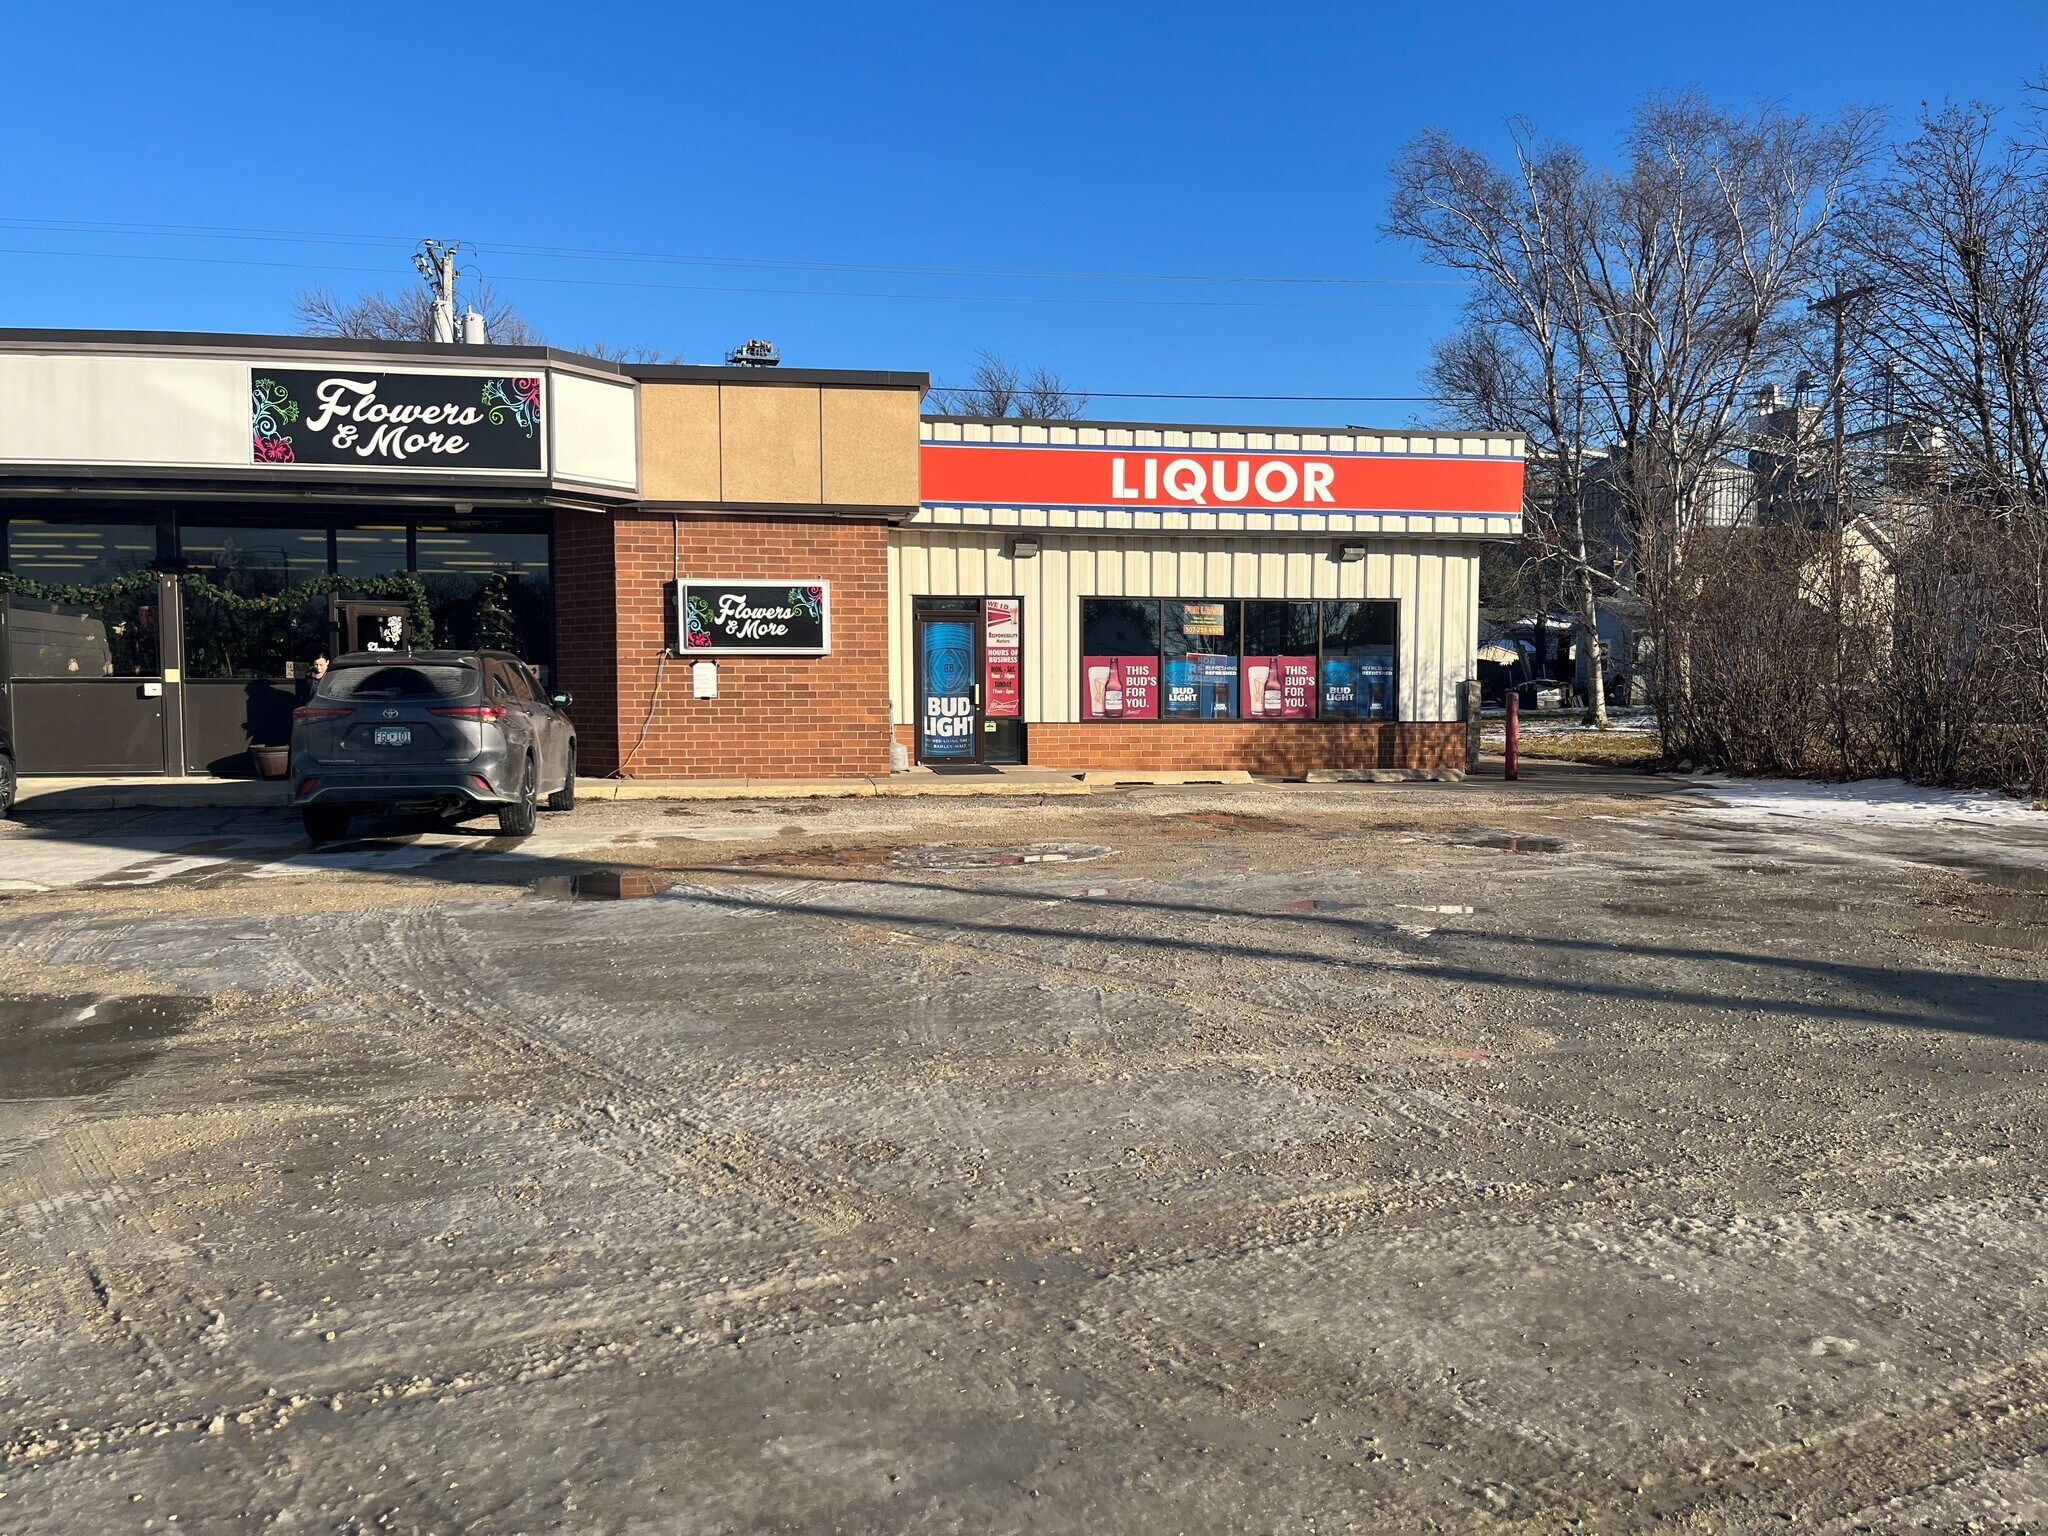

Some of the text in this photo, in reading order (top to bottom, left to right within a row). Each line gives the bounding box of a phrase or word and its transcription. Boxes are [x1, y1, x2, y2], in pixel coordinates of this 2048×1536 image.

[306, 378, 484, 432] Flowers
[332, 423, 470, 460] & More
[1112, 457, 1336, 505] LIQUOR
[987, 600, 999, 608] WE
[714, 593, 795, 626] Flowers
[725, 619, 789, 640] & More
[988, 649, 1010, 657] HOURS
[988, 656, 1018, 664] BUSINESS
[1126, 666, 1150, 675] THIS
[1284, 666, 1308, 675] THIS
[1126, 676, 1157, 686] BUD'S
[1284, 676, 1316, 686] BUD'S
[1126, 688, 1146, 697] FOR
[1172, 687, 1195, 695] BUD
[1284, 688, 1305, 697] FOR
[1169, 694, 1198, 702] LIGHT
[1326, 694, 1354, 702] LIGHT
[927, 696, 971, 717] BUD
[1126, 699, 1150, 708] YOU.
[1284, 698, 1308, 708] YOU.
[924, 715, 974, 737] LIGHT
